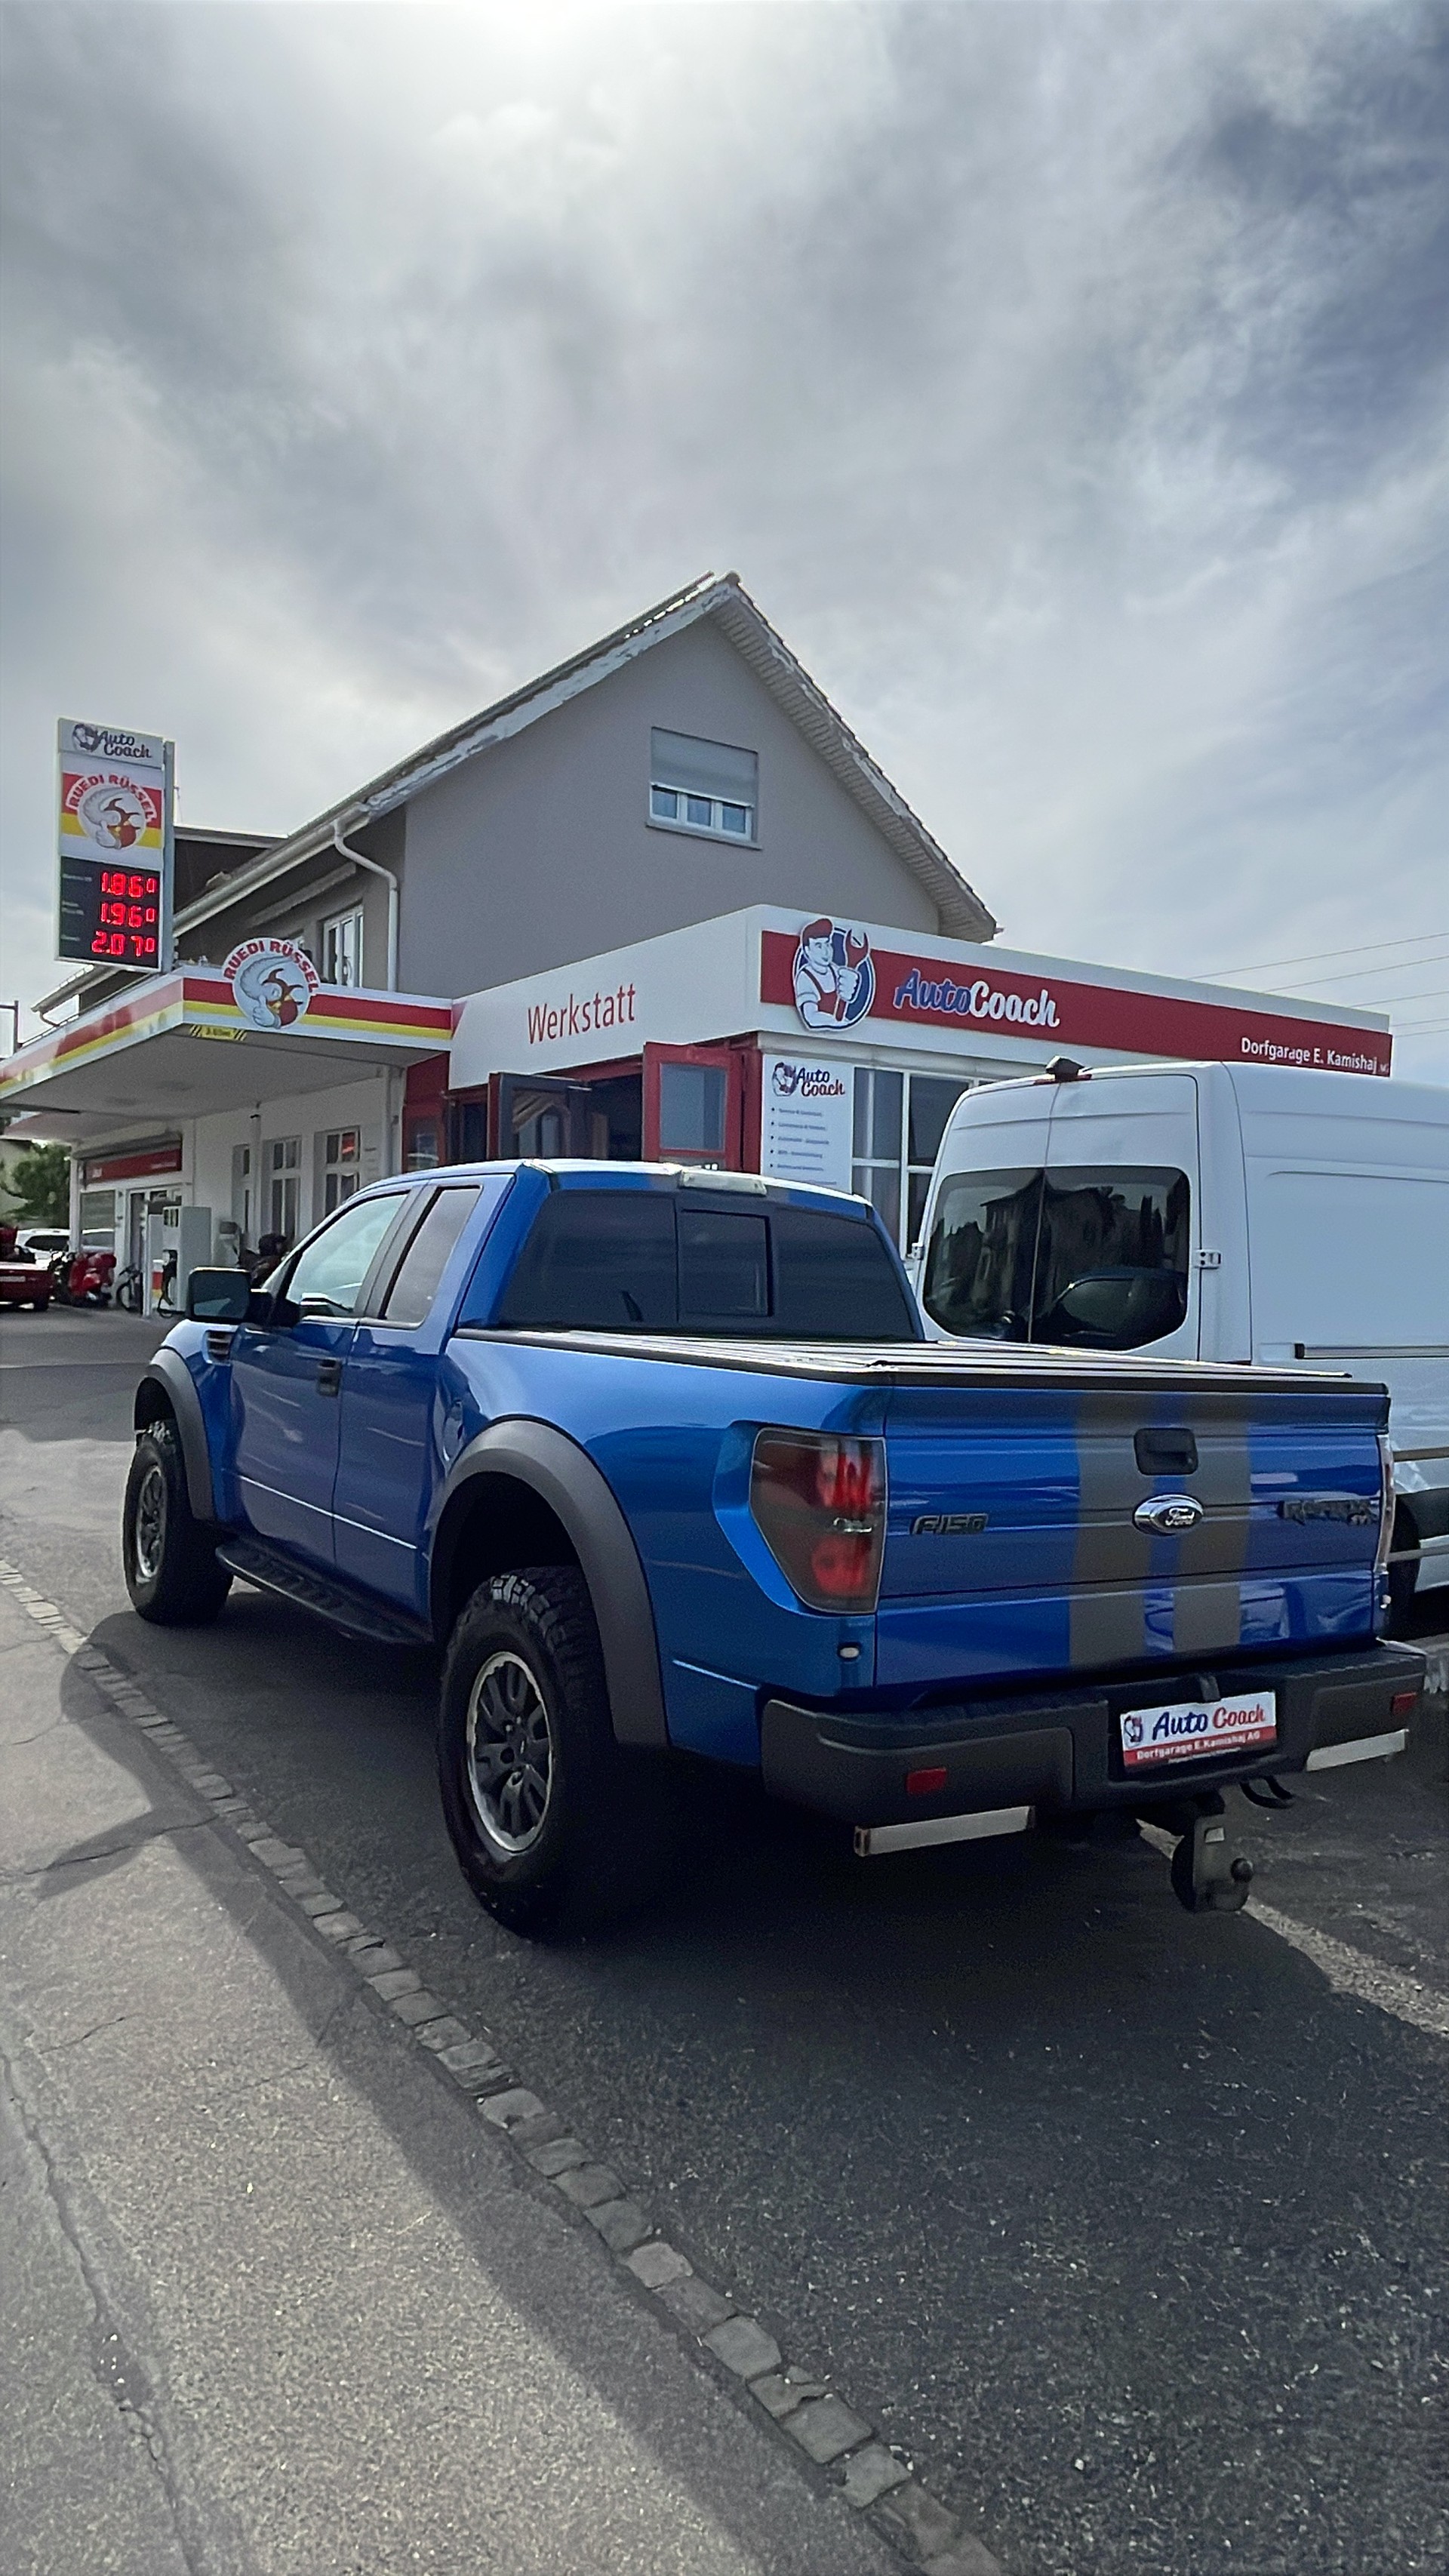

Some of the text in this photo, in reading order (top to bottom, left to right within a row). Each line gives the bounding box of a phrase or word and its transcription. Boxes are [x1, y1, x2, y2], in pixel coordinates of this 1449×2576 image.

[98, 731, 135, 748] Auto
[104, 743, 152, 759] Coach
[68, 774, 105, 808] RUEDI
[223, 939, 319, 993] RUEDI RÜSSEL
[528, 983, 635, 1045] Werkstatt
[1241, 1036, 1311, 1064] Dorfgarage
[1313, 1048, 1324, 1063] E.
[1327, 1049, 1377, 1075] Kamishaj
[796, 1066, 830, 1085] Auto
[801, 1079, 846, 1097] Coach
[1152, 1703, 1266, 1740] Auto Coach
[1137, 1742, 1193, 1760] Dorfgarage
